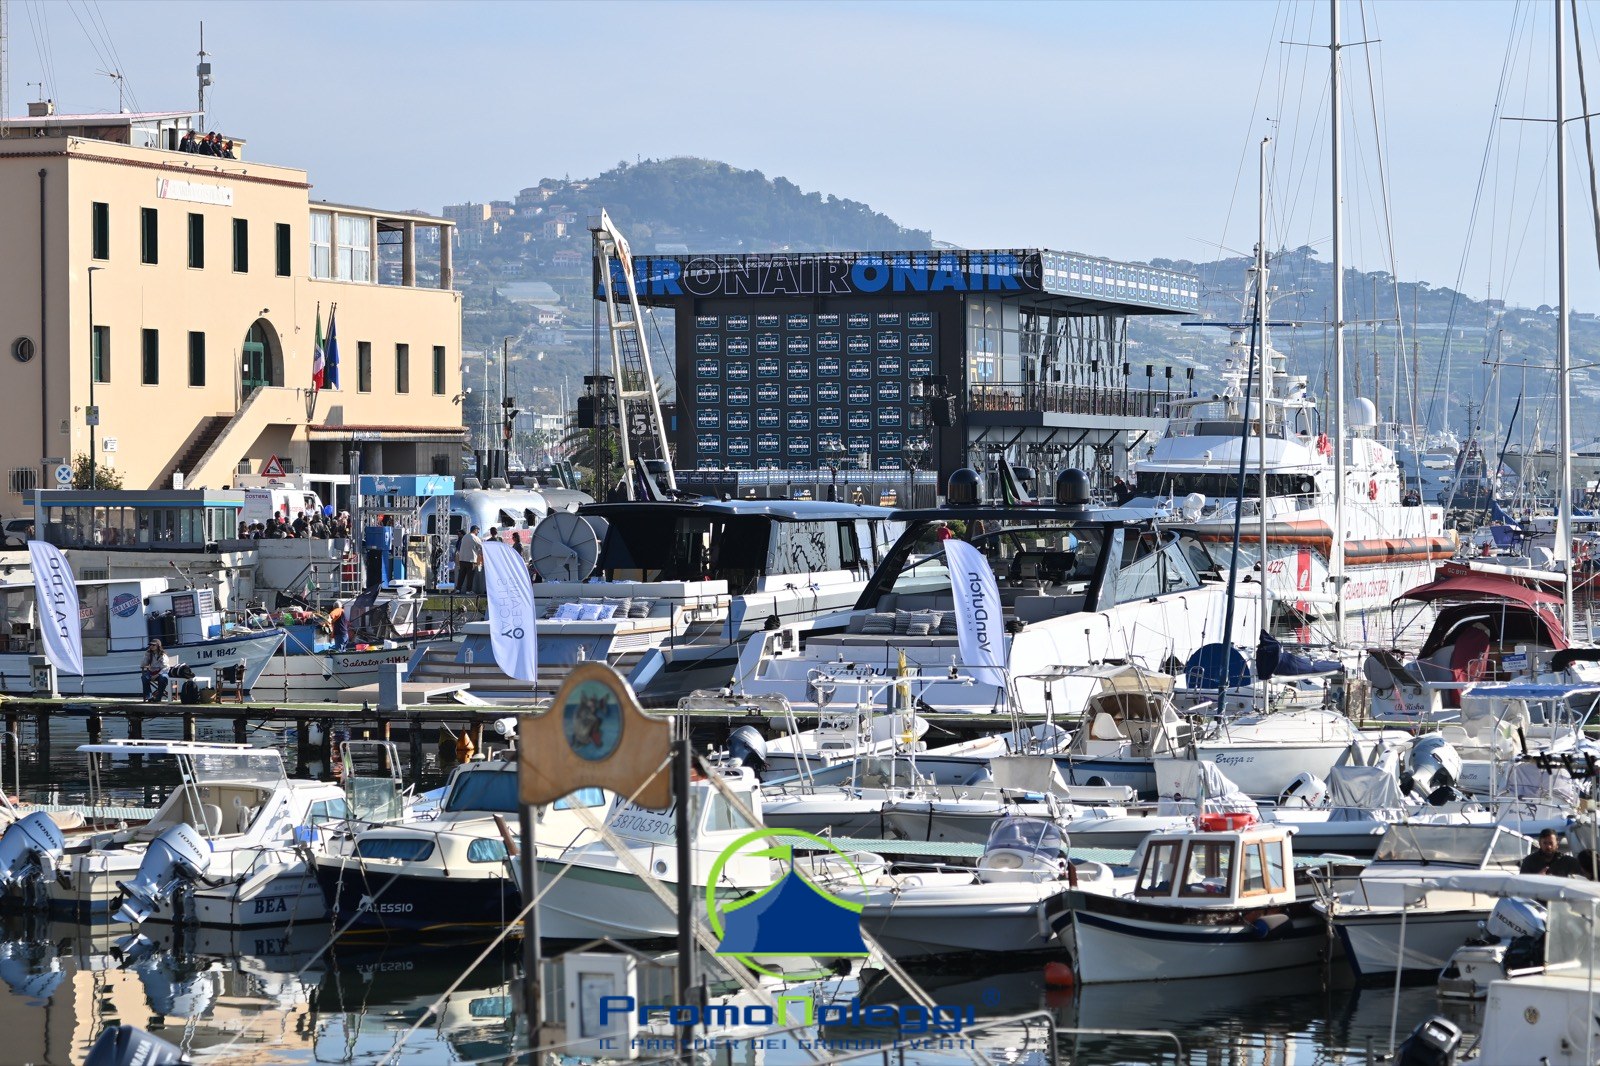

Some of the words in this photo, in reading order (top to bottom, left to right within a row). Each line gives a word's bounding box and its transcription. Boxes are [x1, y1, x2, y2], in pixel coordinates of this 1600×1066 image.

[684, 255, 851, 295] ONAIR
[851, 253, 1021, 292] ONAIR
[1267, 561, 1284, 574] 422
[216, 647, 237, 658] 1842
[1215, 753, 1244, 766] Brezza
[34, 820, 58, 849] HONDA
[177, 831, 203, 858] HONDA
[254, 897, 287, 914] BEA
[365, 903, 413, 913] ALESSIO
[1495, 912, 1529, 936] HONDA
